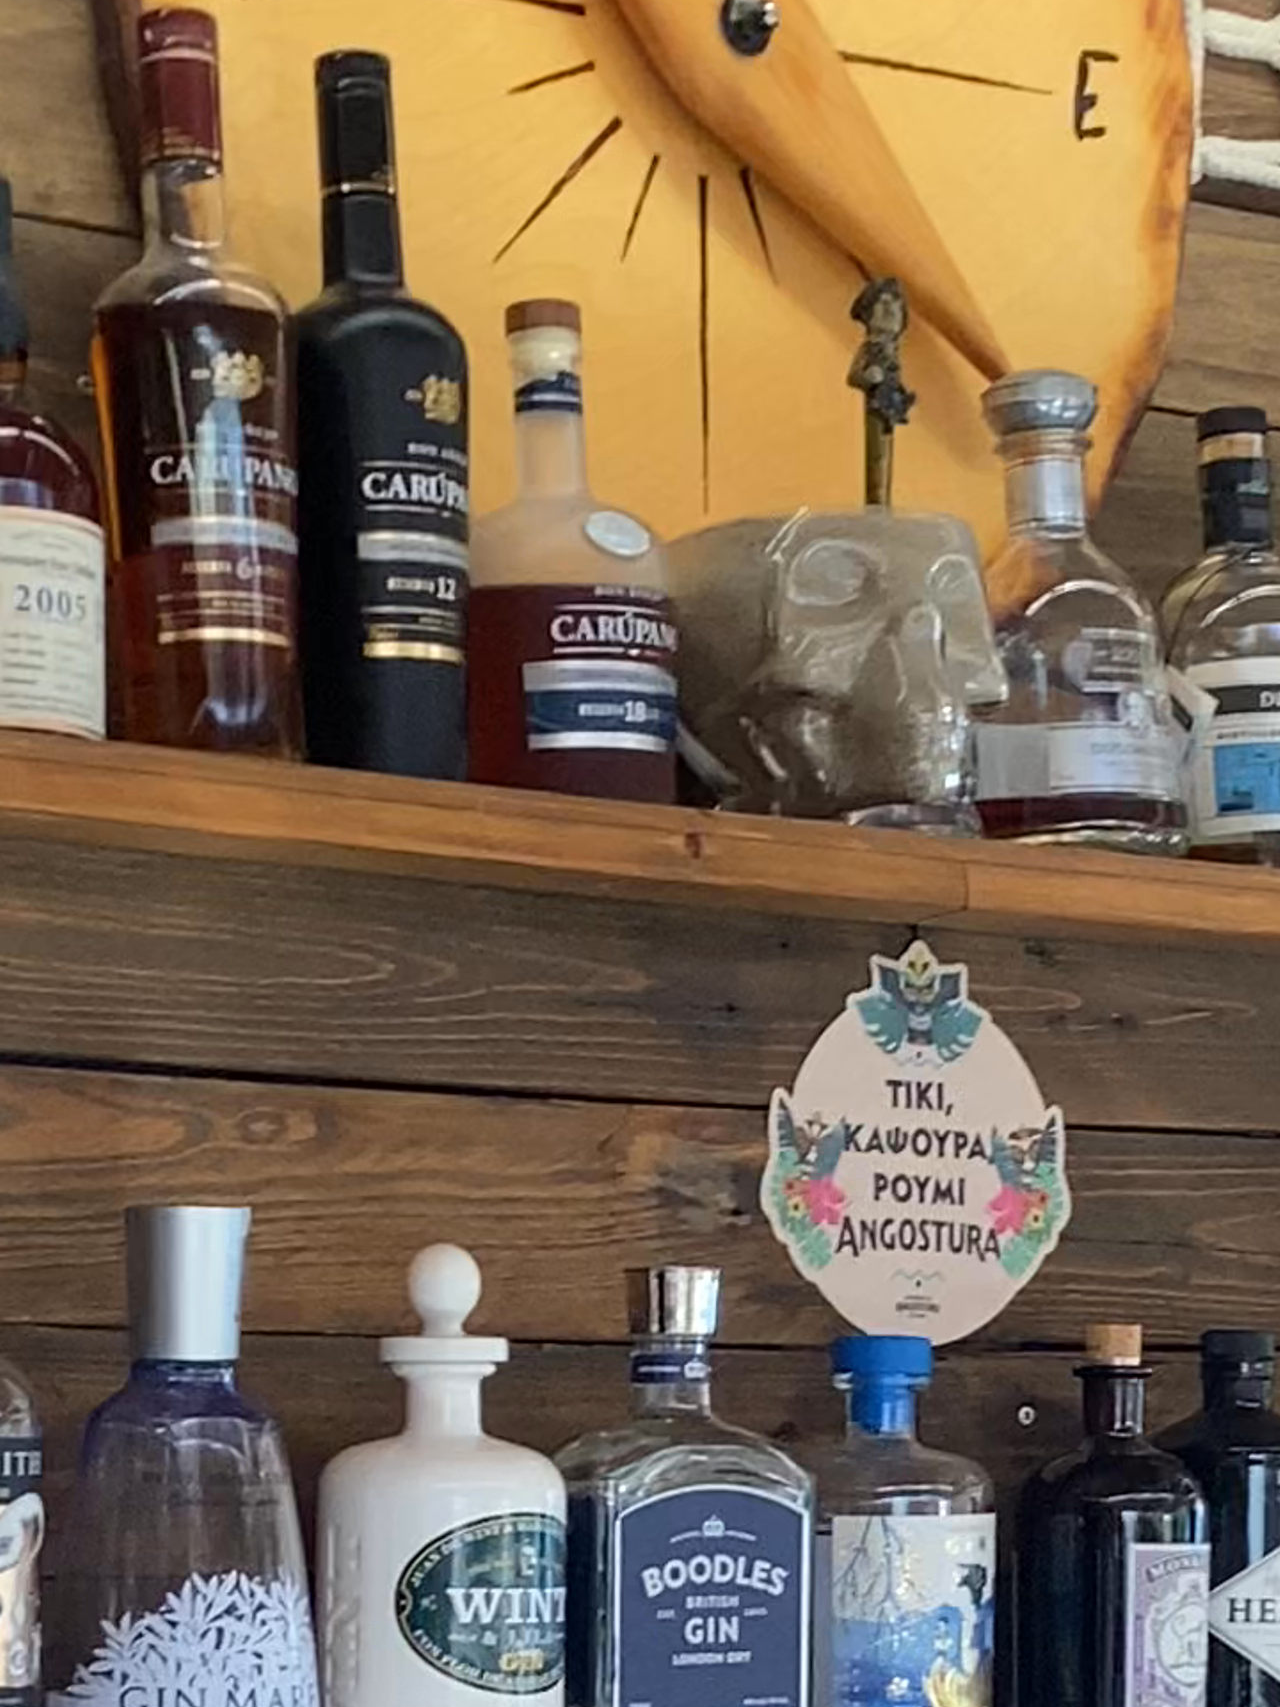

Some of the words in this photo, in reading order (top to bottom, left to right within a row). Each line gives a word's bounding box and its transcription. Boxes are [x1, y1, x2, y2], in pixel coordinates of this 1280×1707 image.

[1073, 50, 1120, 140] E
[14, 583, 89, 621] 2005
[885, 1078, 955, 1117] TIKI,
[835, 1214, 1002, 1263] ANGOSTURA
[640, 1552, 790, 1600] BOODLES
[683, 1615, 741, 1646] GIN
